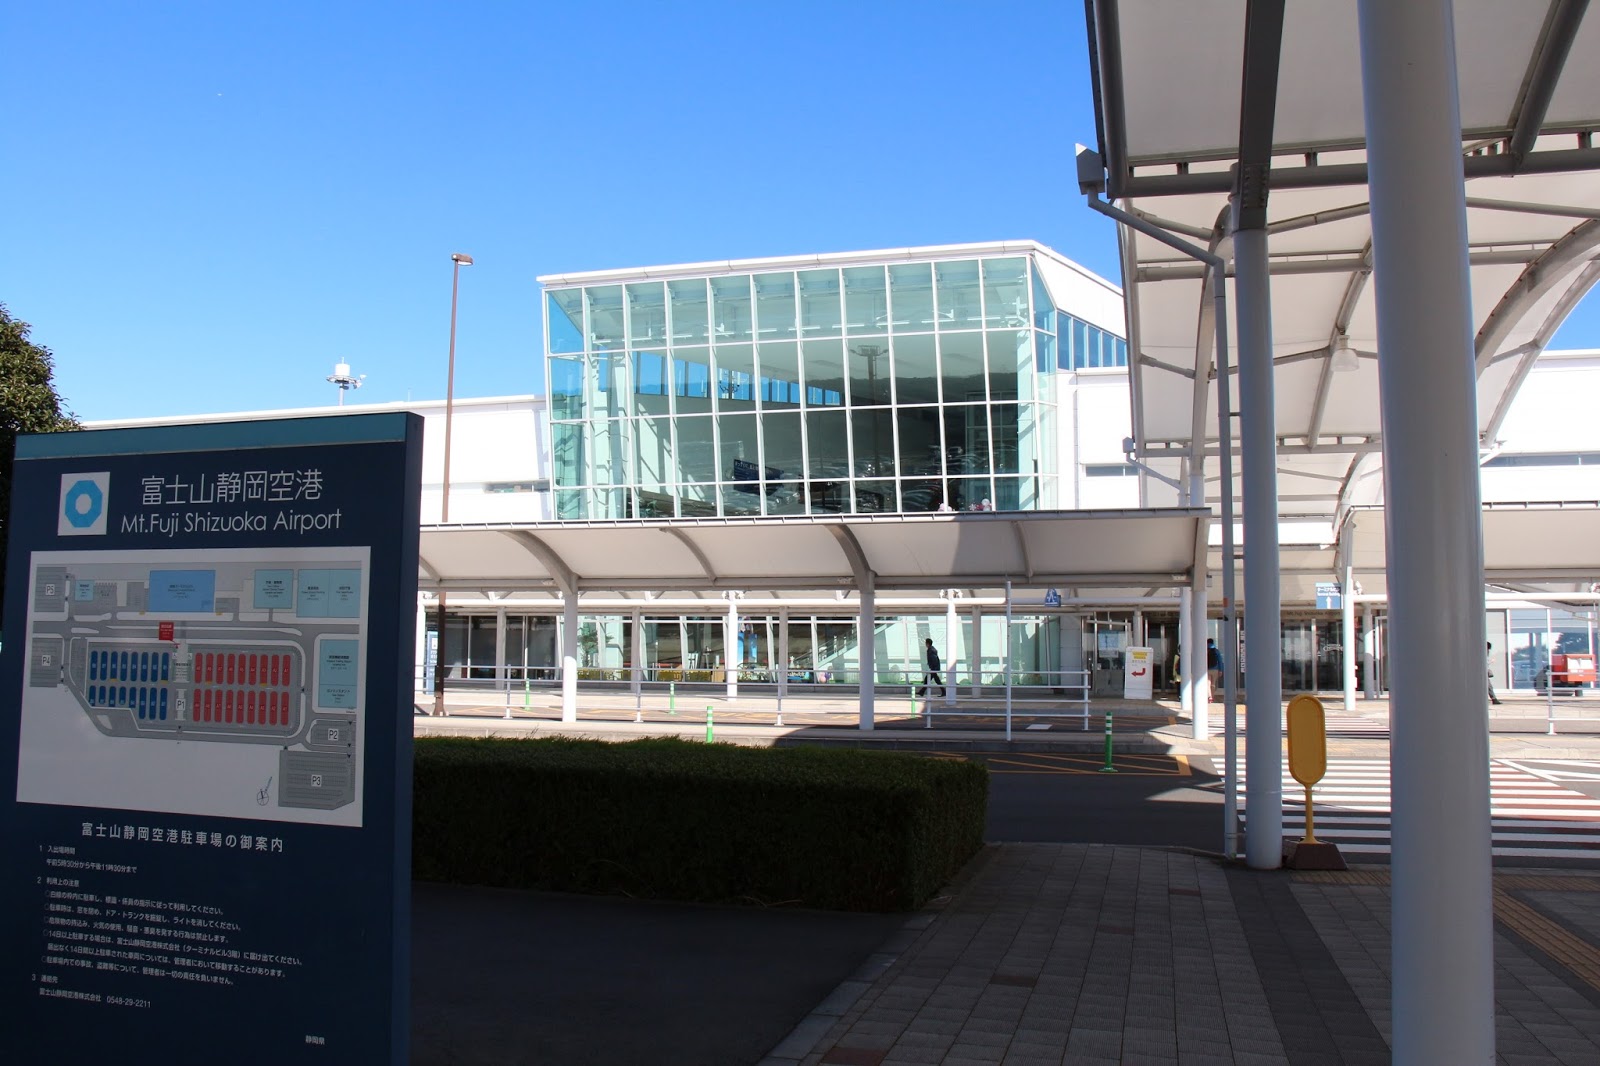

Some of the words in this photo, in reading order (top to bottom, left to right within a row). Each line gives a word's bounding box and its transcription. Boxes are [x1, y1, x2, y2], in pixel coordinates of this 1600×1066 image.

[142, 469, 323, 505] 富士山静岡空港
[121, 513, 179, 537] Mt.Fuji
[184, 511, 266, 532] Shizuoka
[274, 508, 341, 534] Airport
[46, 585, 54, 596] P5
[42, 656, 50, 665] P4
[176, 700, 186, 710] P1
[328, 729, 338, 740] P2
[312, 774, 322, 786] P3
[82, 822, 283, 852] 富士山静岡空港駐車場の御案内
[37, 876, 42, 884] 2
[32, 974, 37, 982] 3
[40, 988, 102, 1002] 富士山静岡空港株式会社
[107, 996, 151, 1008] 0548-29-2211
[306, 1035, 325, 1046] 静岡県
